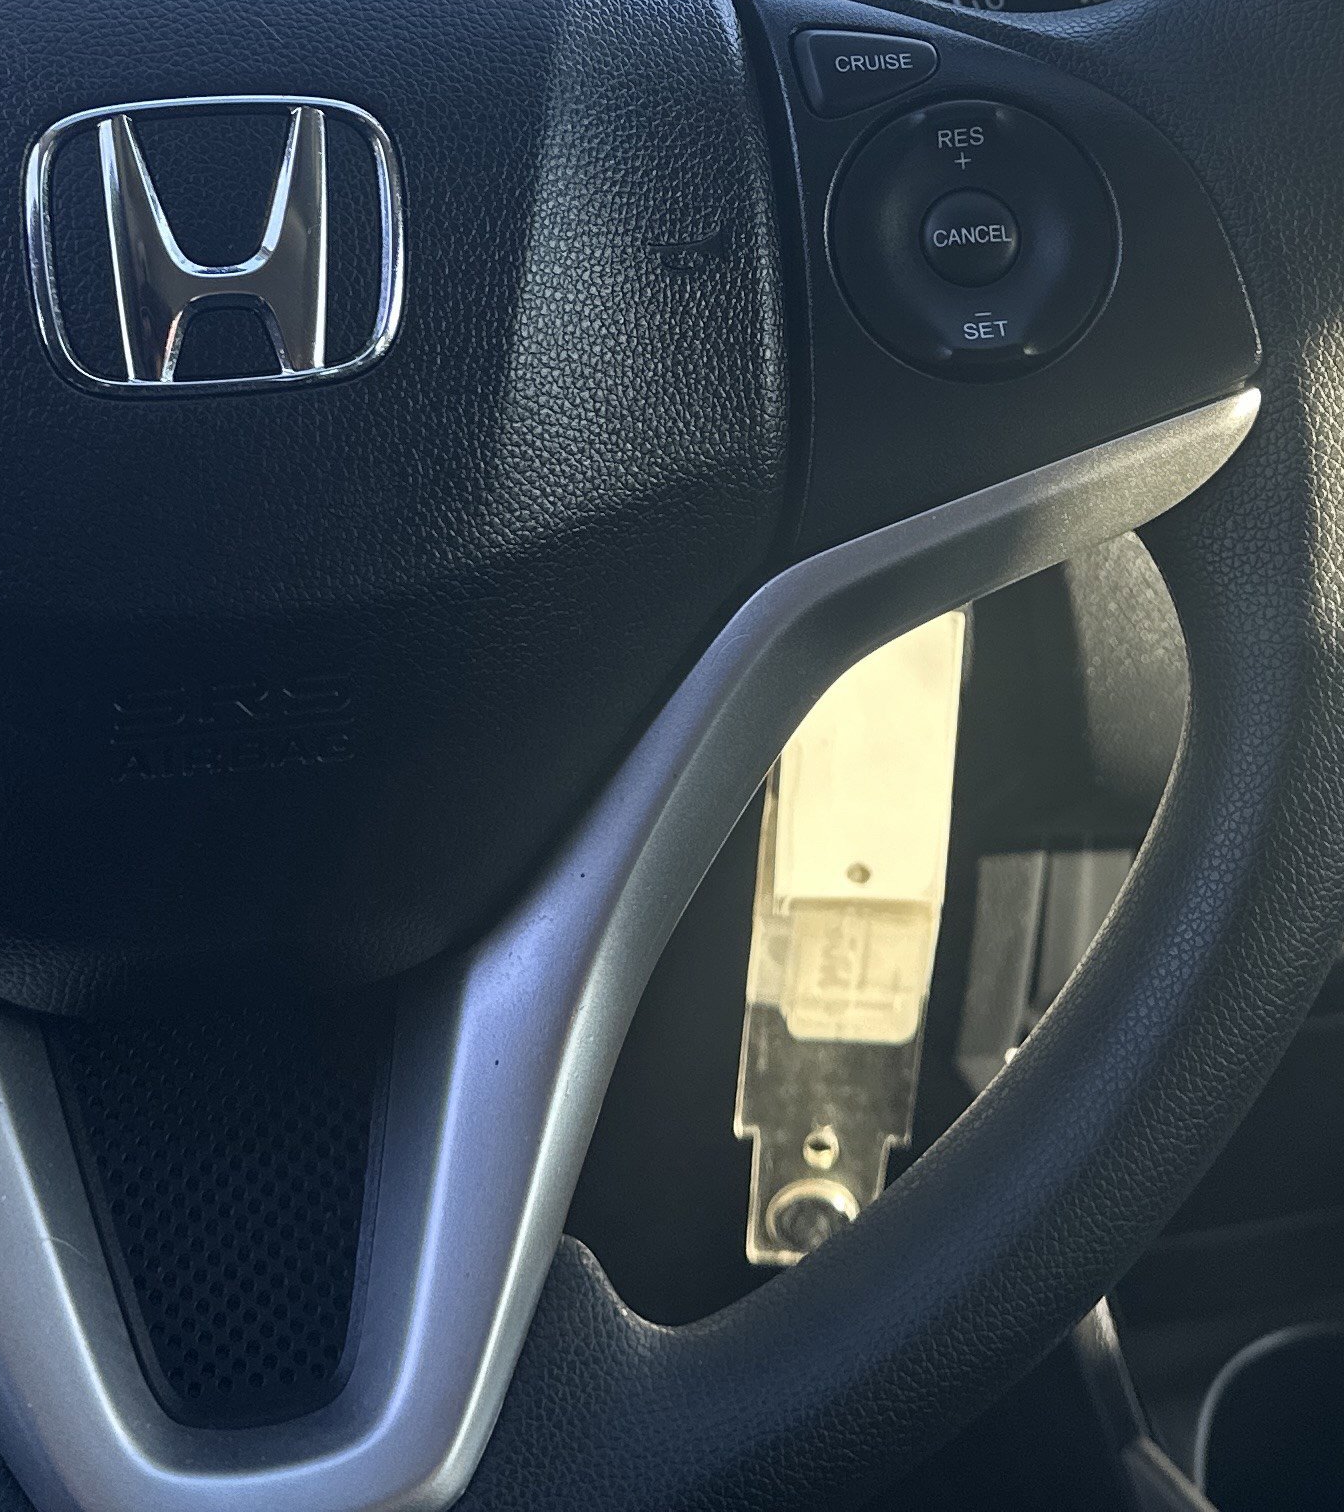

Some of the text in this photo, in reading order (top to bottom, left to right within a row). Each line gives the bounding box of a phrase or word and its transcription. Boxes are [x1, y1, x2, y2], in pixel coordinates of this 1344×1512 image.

[835, 53, 913, 73] CRUISE
[937, 127, 985, 149] RES
[932, 224, 1013, 248] CANCEL
[963, 320, 1008, 340] SET
